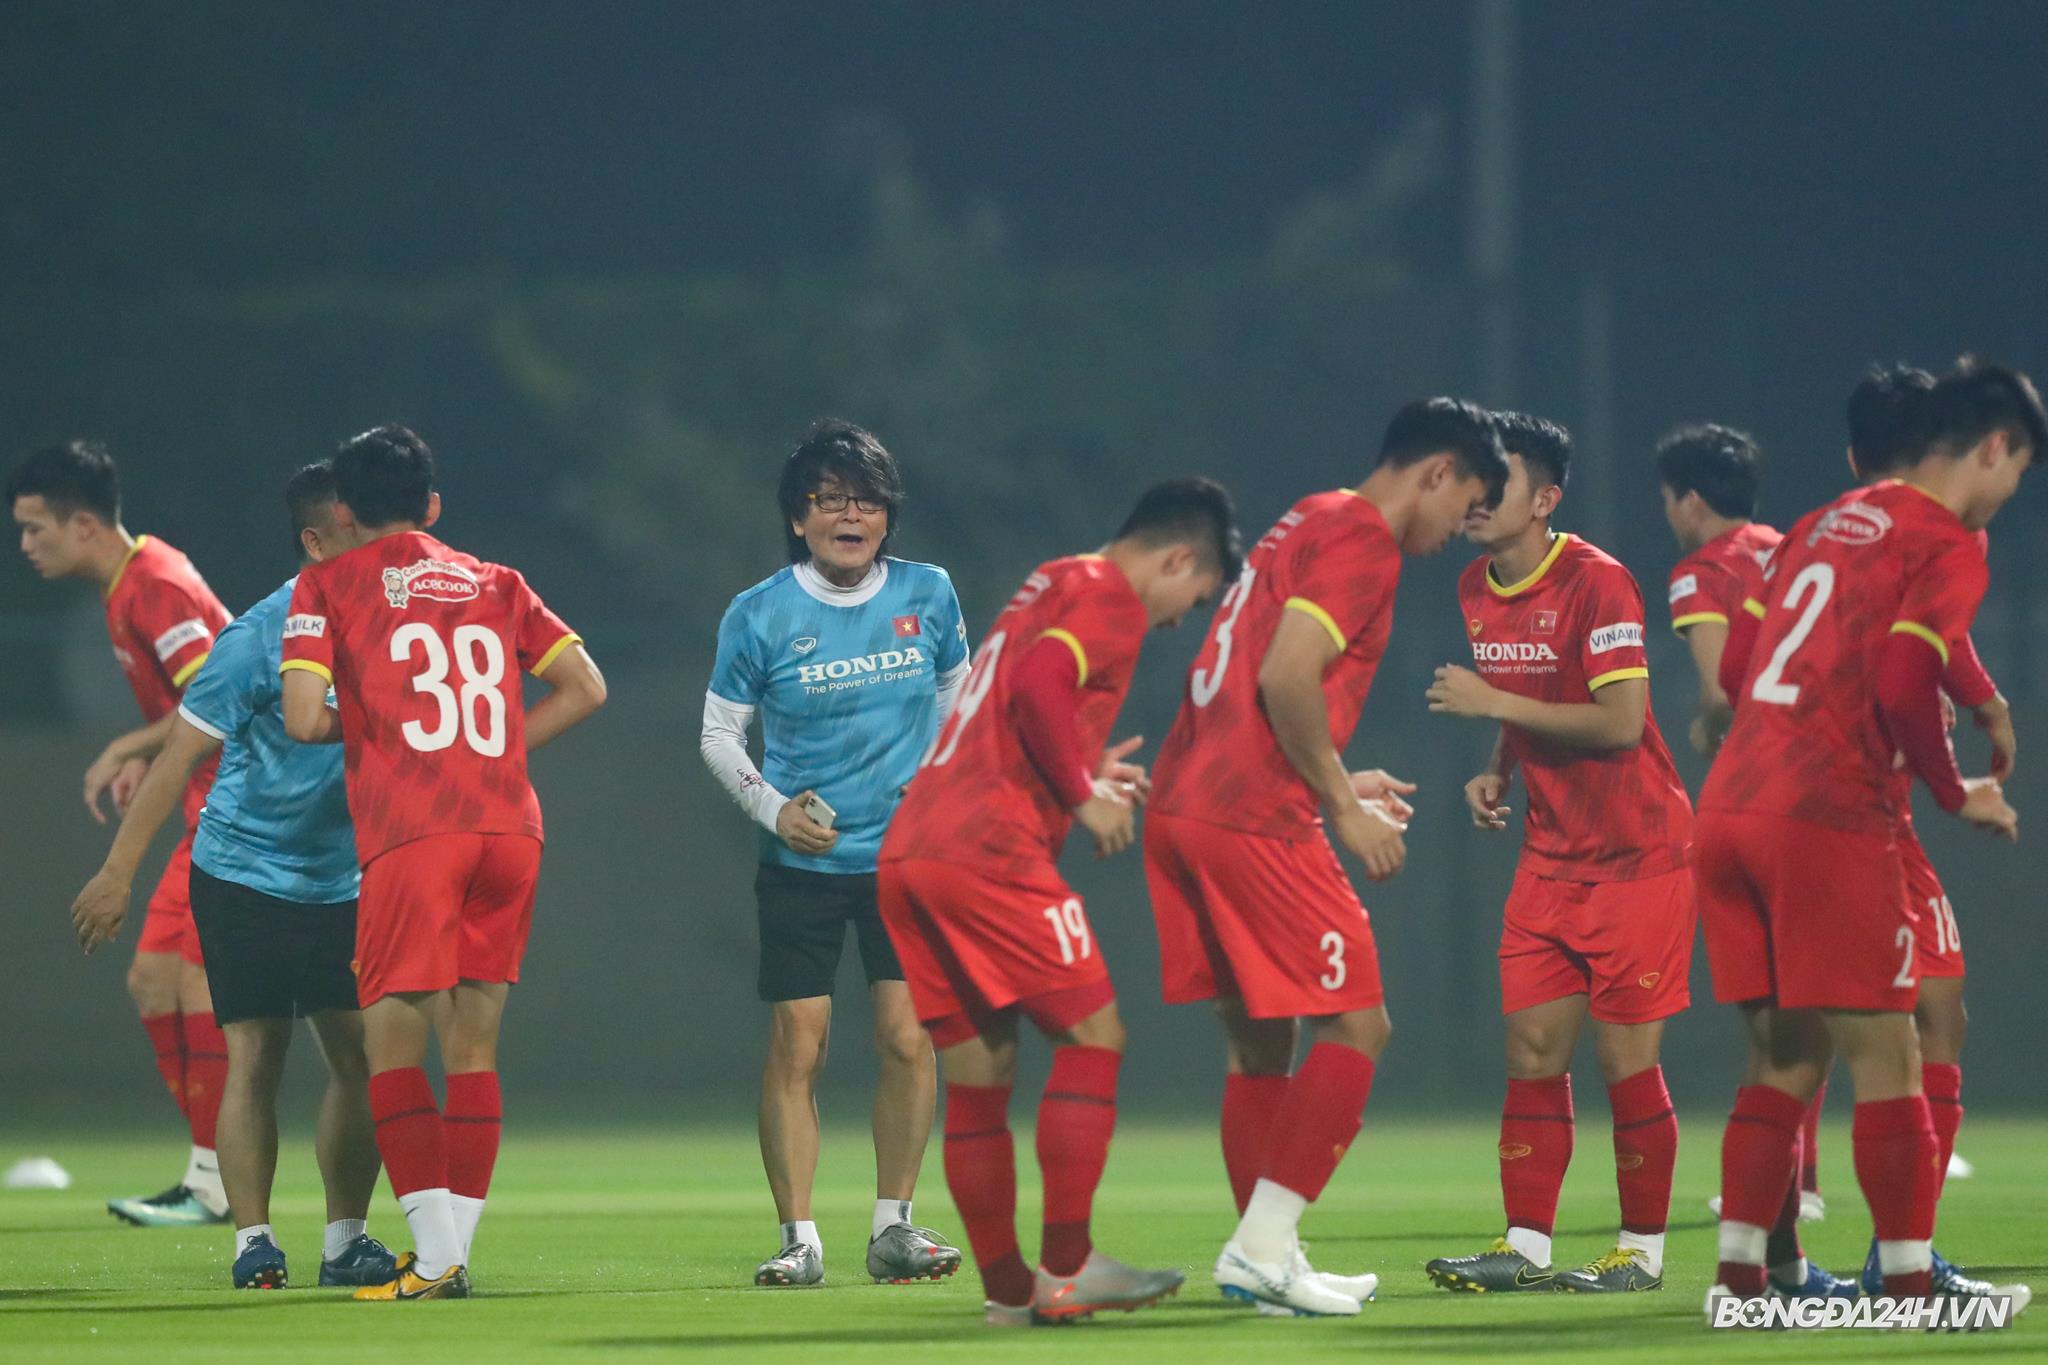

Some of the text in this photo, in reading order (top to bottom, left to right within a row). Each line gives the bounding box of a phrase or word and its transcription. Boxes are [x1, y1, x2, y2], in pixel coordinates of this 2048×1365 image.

[1472, 643, 1558, 661] HONDA
[1752, 562, 1835, 706] 2
[390, 622, 506, 758] 38
[798, 647, 924, 683] HONDA
[804, 667, 924, 695] The Power of Dreams
[1488, 664, 1512, 674] Power
[1513, 665, 1521, 674] of
[1043, 898, 1091, 967] 19
[1928, 894, 1961, 955] 18
[1320, 930, 1347, 990] 3
[1893, 925, 1915, 988] 2
